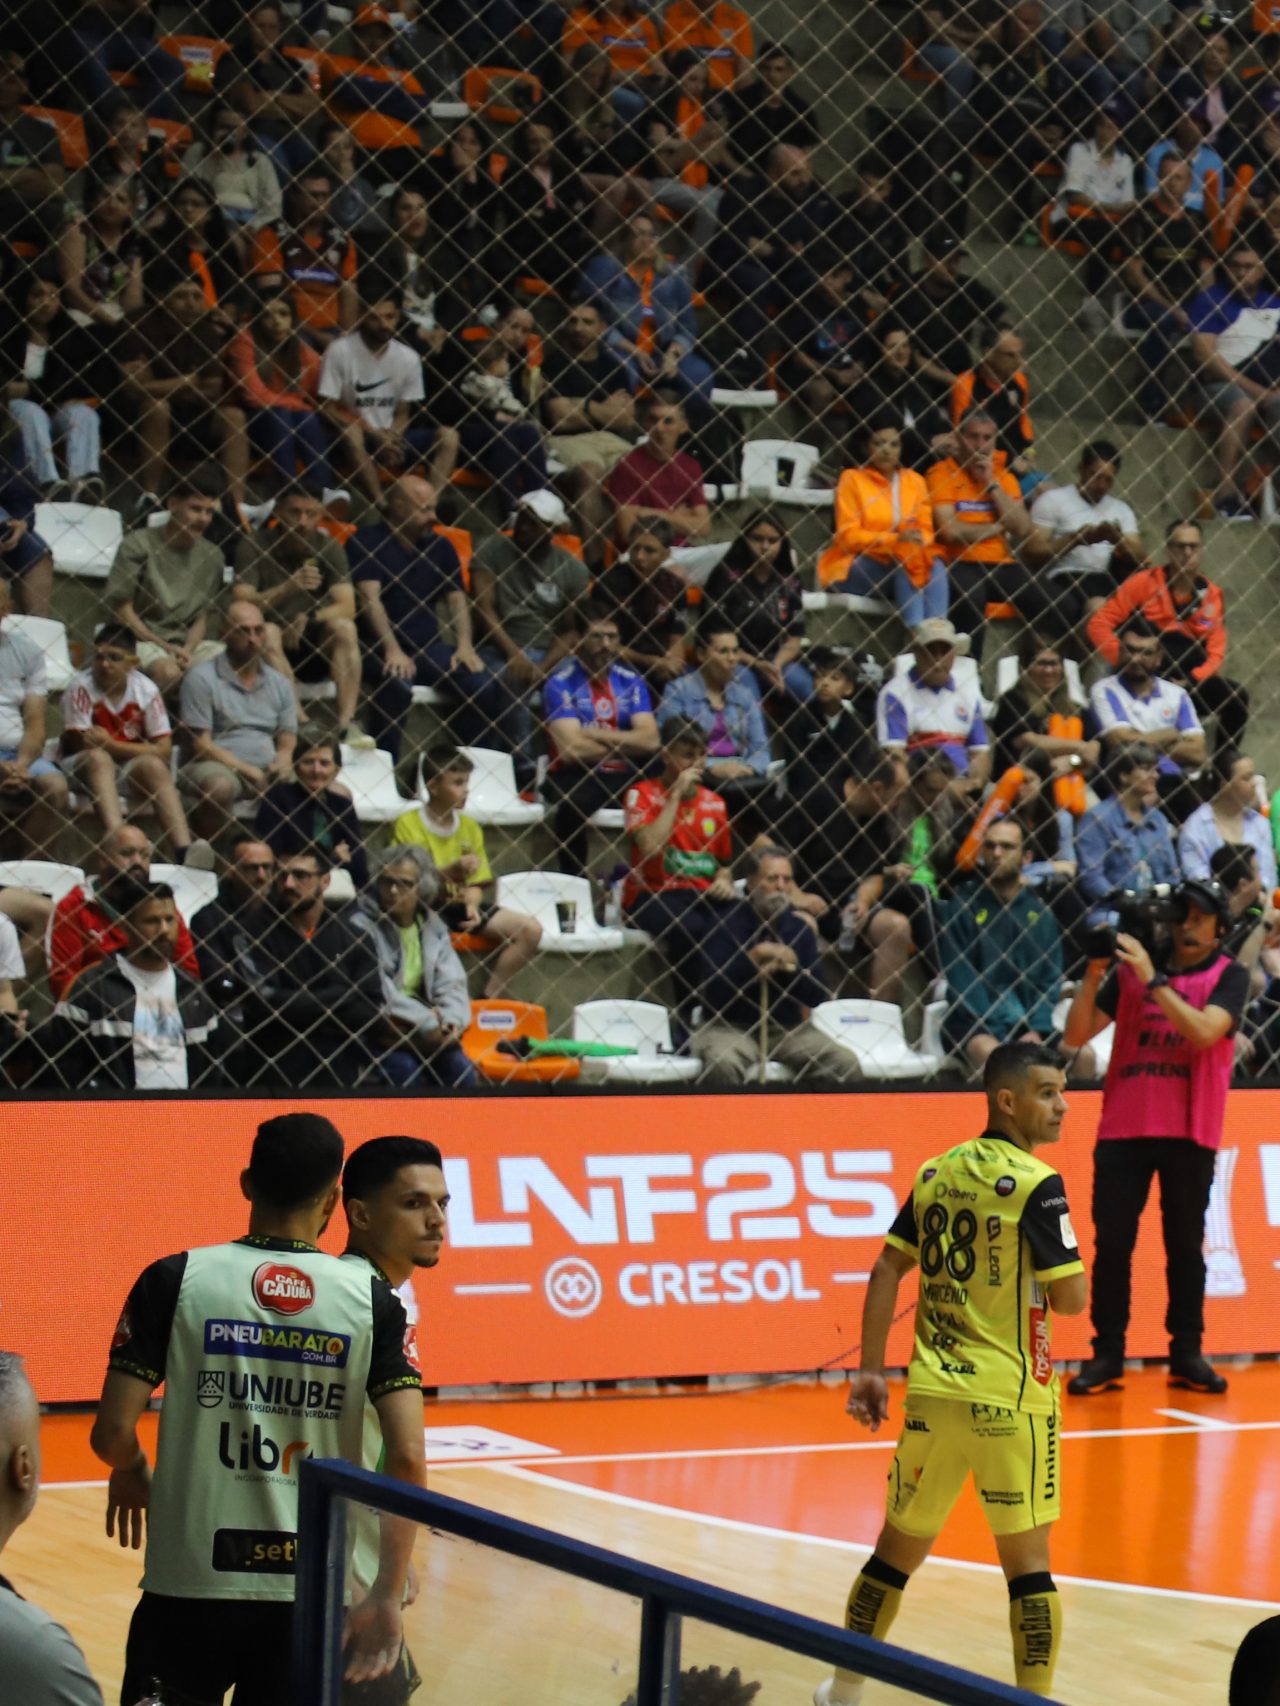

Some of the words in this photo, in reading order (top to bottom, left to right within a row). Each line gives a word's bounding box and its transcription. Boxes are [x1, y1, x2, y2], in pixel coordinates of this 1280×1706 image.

[441, 1149, 898, 1248] LNF25
[920, 1202, 978, 1282] 88
[262, 1279, 312, 1299] CAJUBÁ
[619, 1259, 822, 1306] CRESOL
[210, 1323, 344, 1355] PNEUBARATO
[301, 1351, 337, 1363] COM.BR
[1035, 1321, 1049, 1378] TOPSUN
[229, 1372, 346, 1411] UNIUBE
[229, 1401, 289, 1416] UNIVERSIDADE
[304, 1410, 340, 1420] VERDADE
